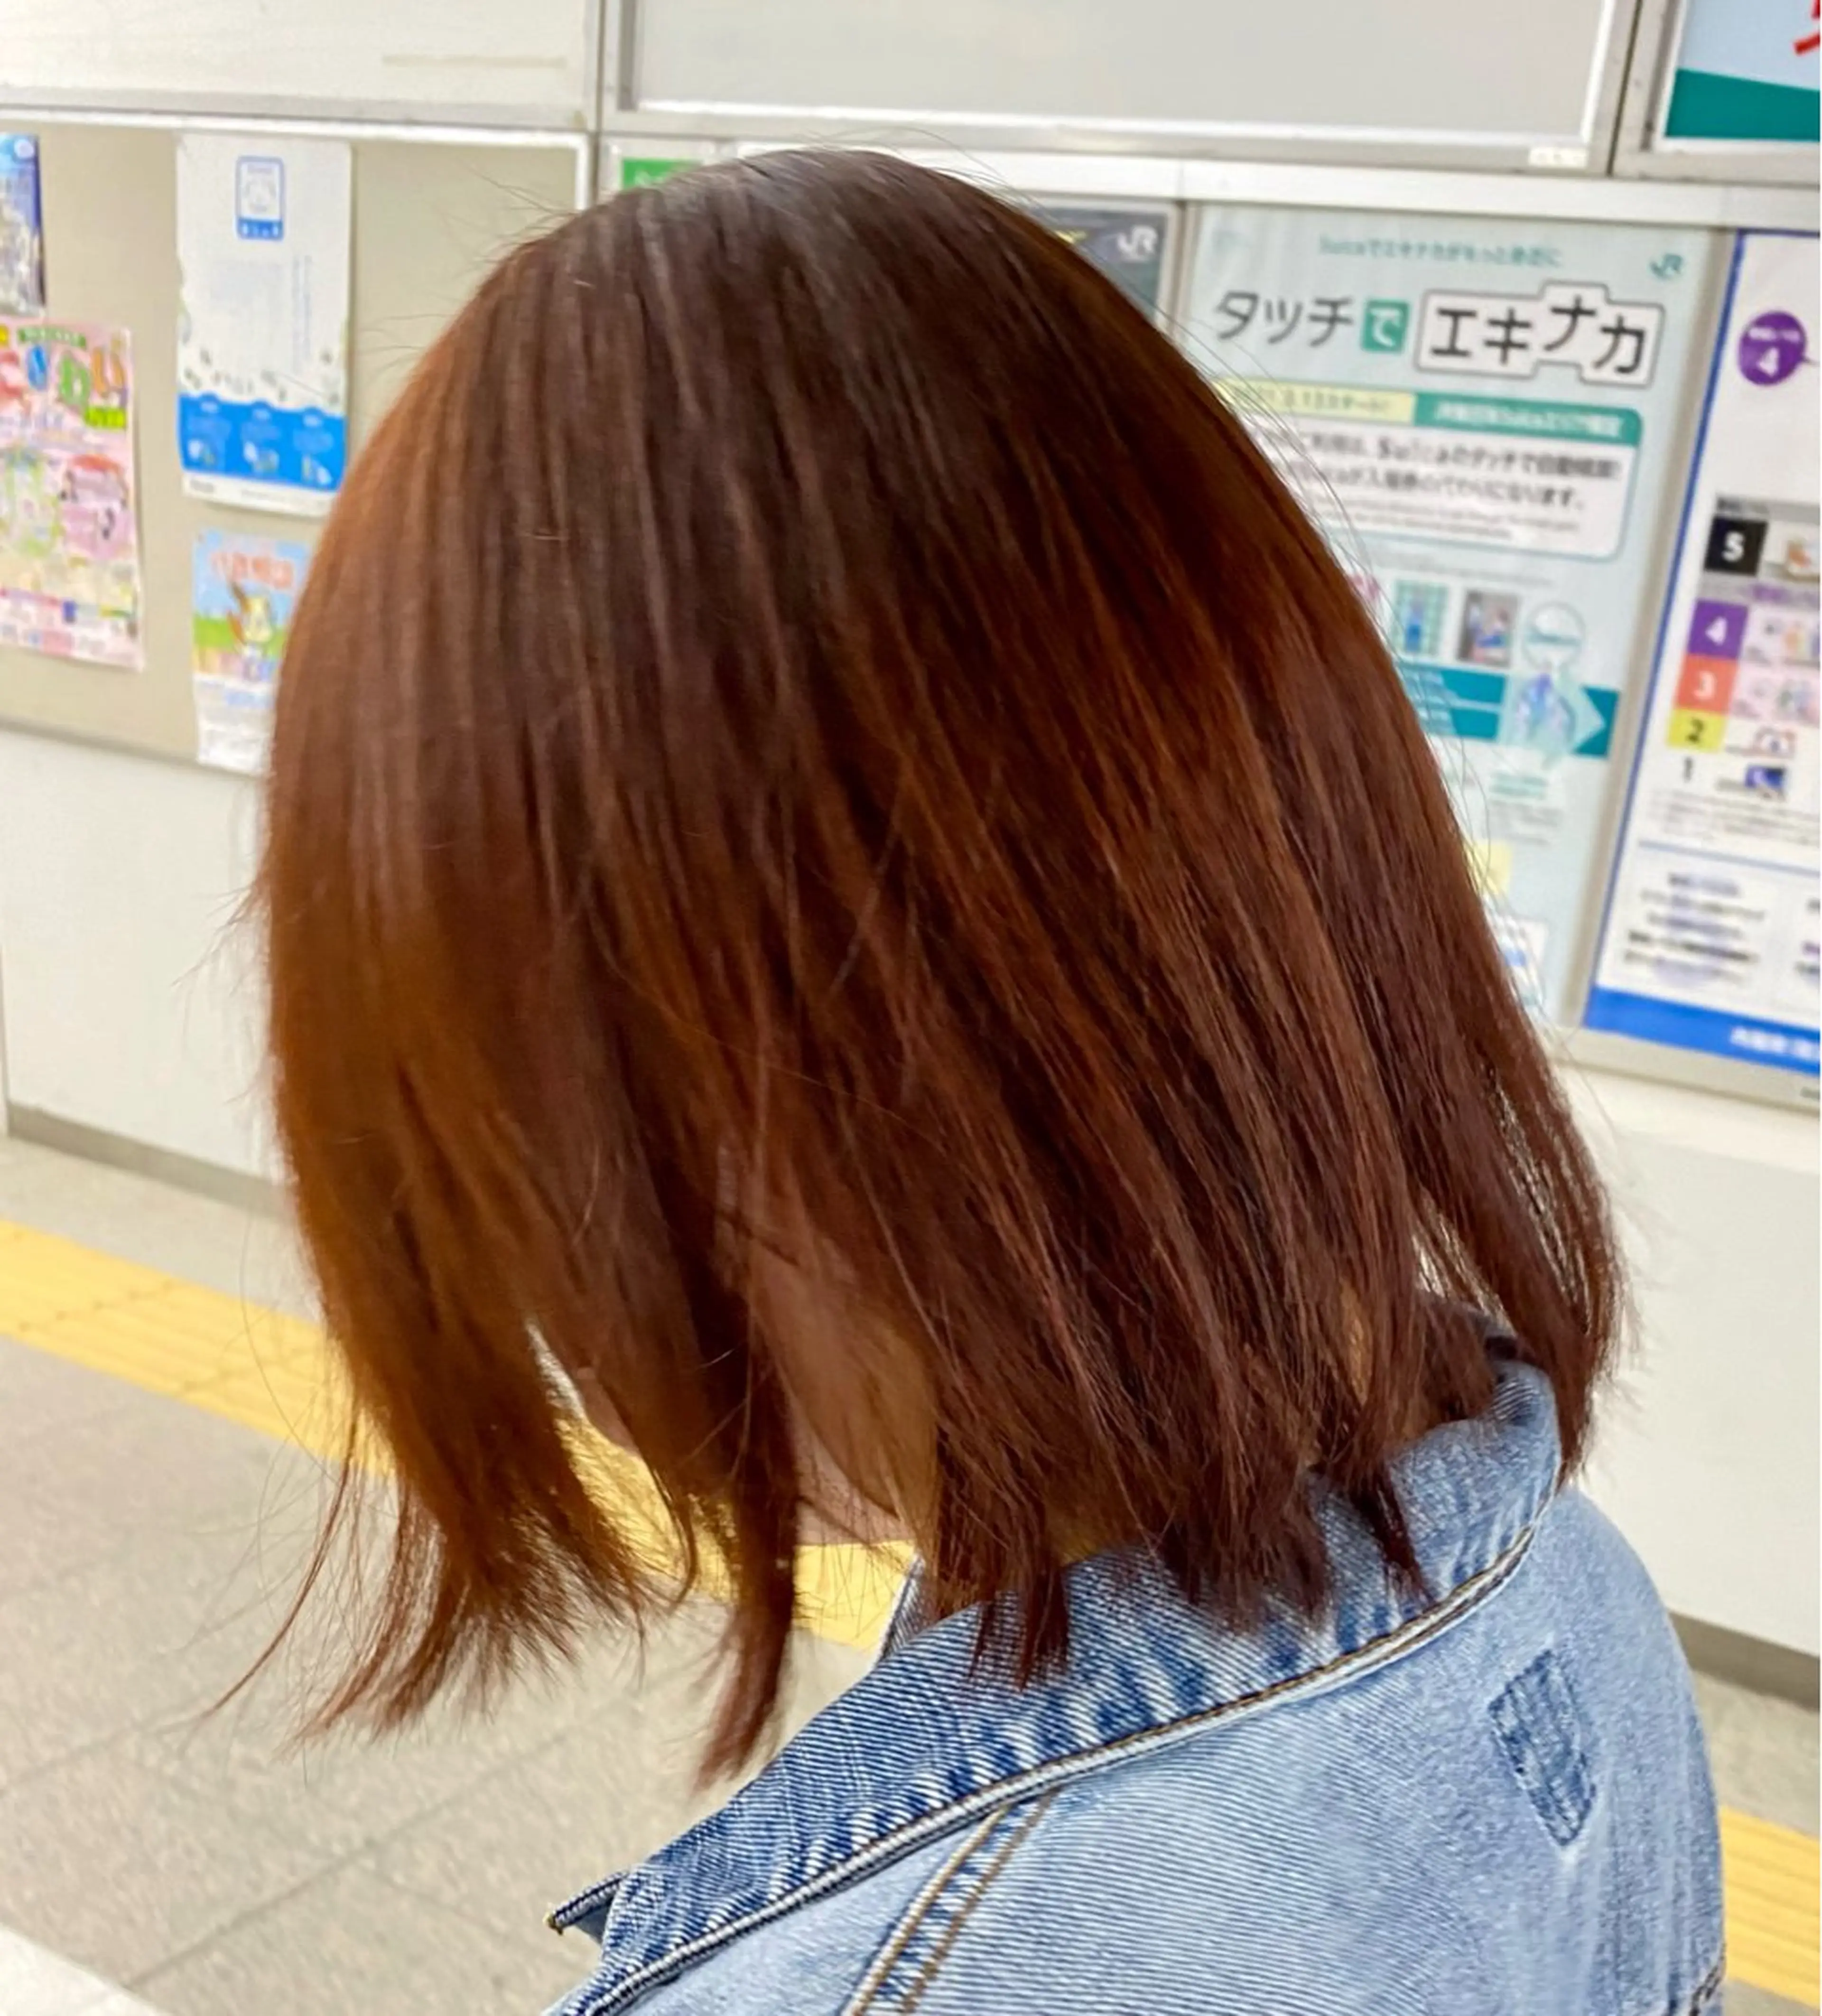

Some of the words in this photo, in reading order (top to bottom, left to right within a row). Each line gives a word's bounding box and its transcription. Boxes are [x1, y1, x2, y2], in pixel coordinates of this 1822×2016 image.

[1117, 225, 1159, 260] JR
[1705, 616, 1729, 645] 4
[1693, 670, 1717, 700] 3
[1685, 716, 1705, 744] 2
